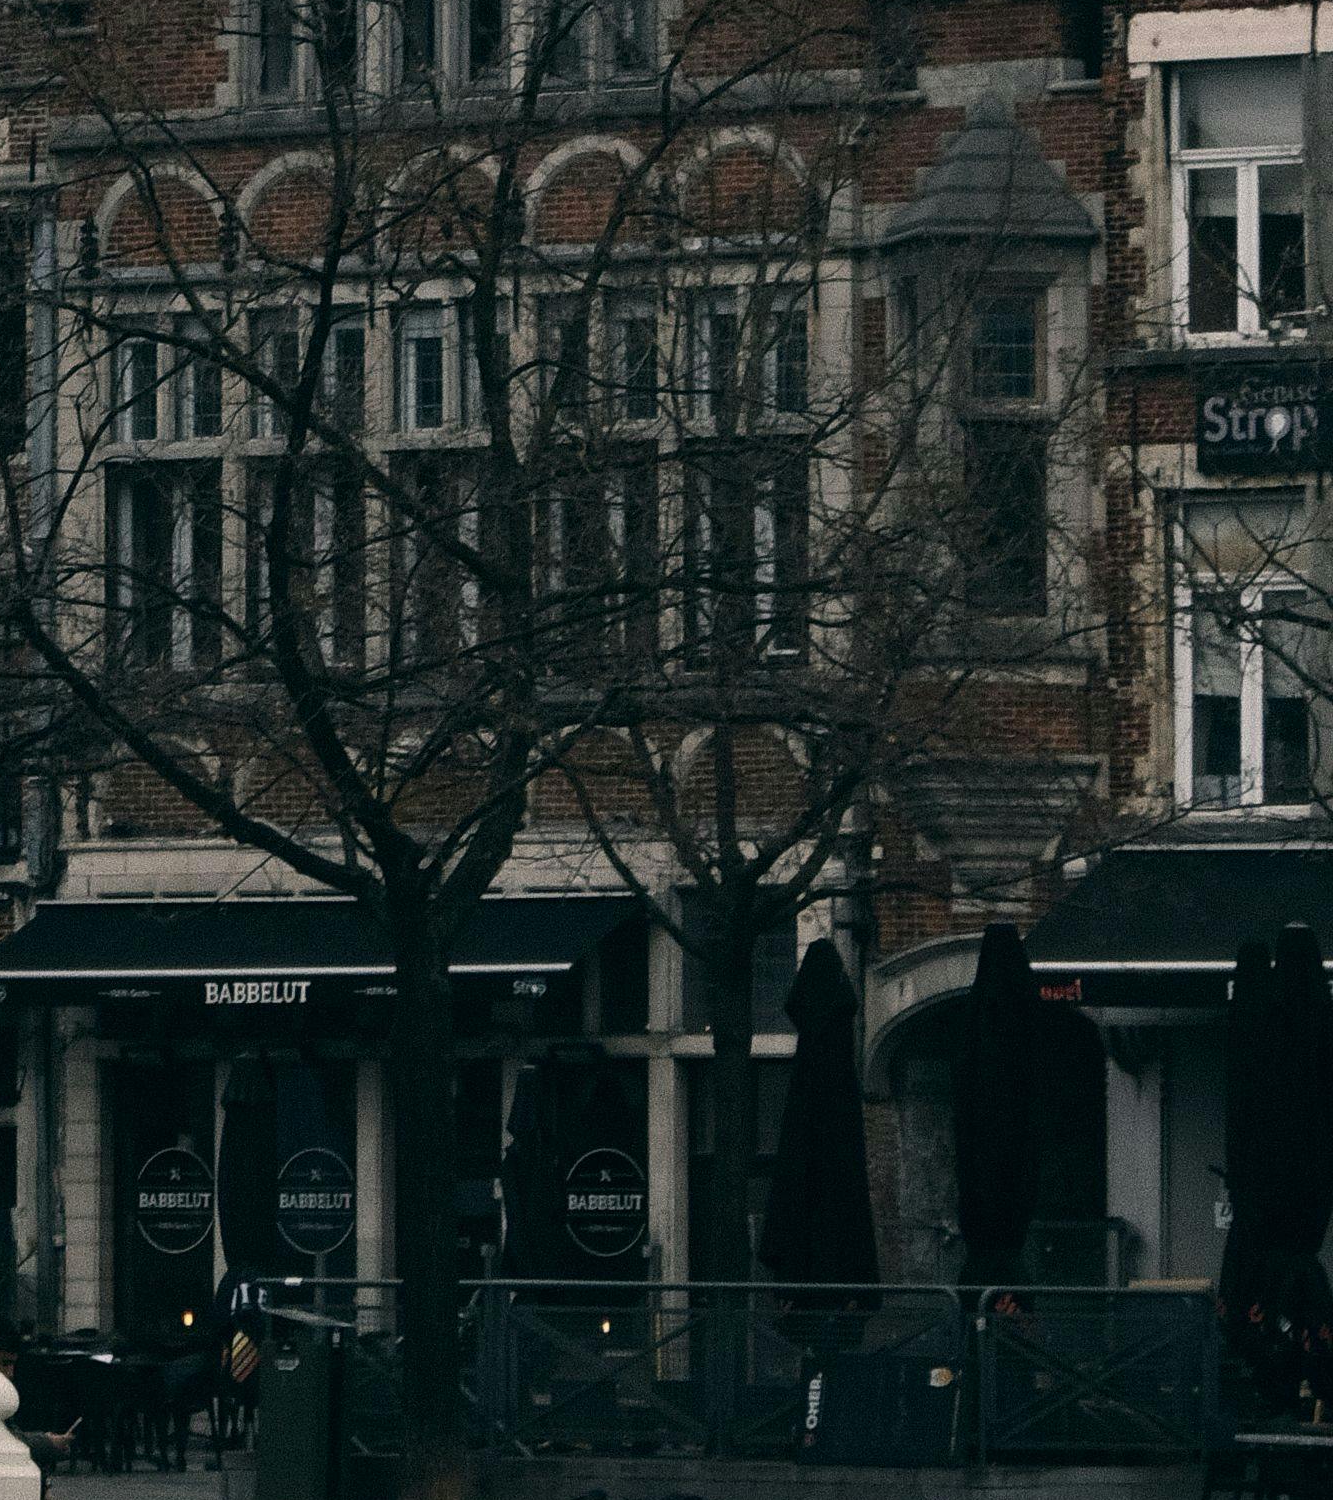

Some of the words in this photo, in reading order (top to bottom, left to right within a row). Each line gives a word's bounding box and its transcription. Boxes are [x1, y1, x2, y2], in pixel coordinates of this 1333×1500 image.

[204, 981, 311, 1005] BABBELUT
[138, 1192, 212, 1209] BABBELUT
[278, 1192, 353, 1210] BABBELUT
[567, 1193, 643, 1211] BABBELUT
